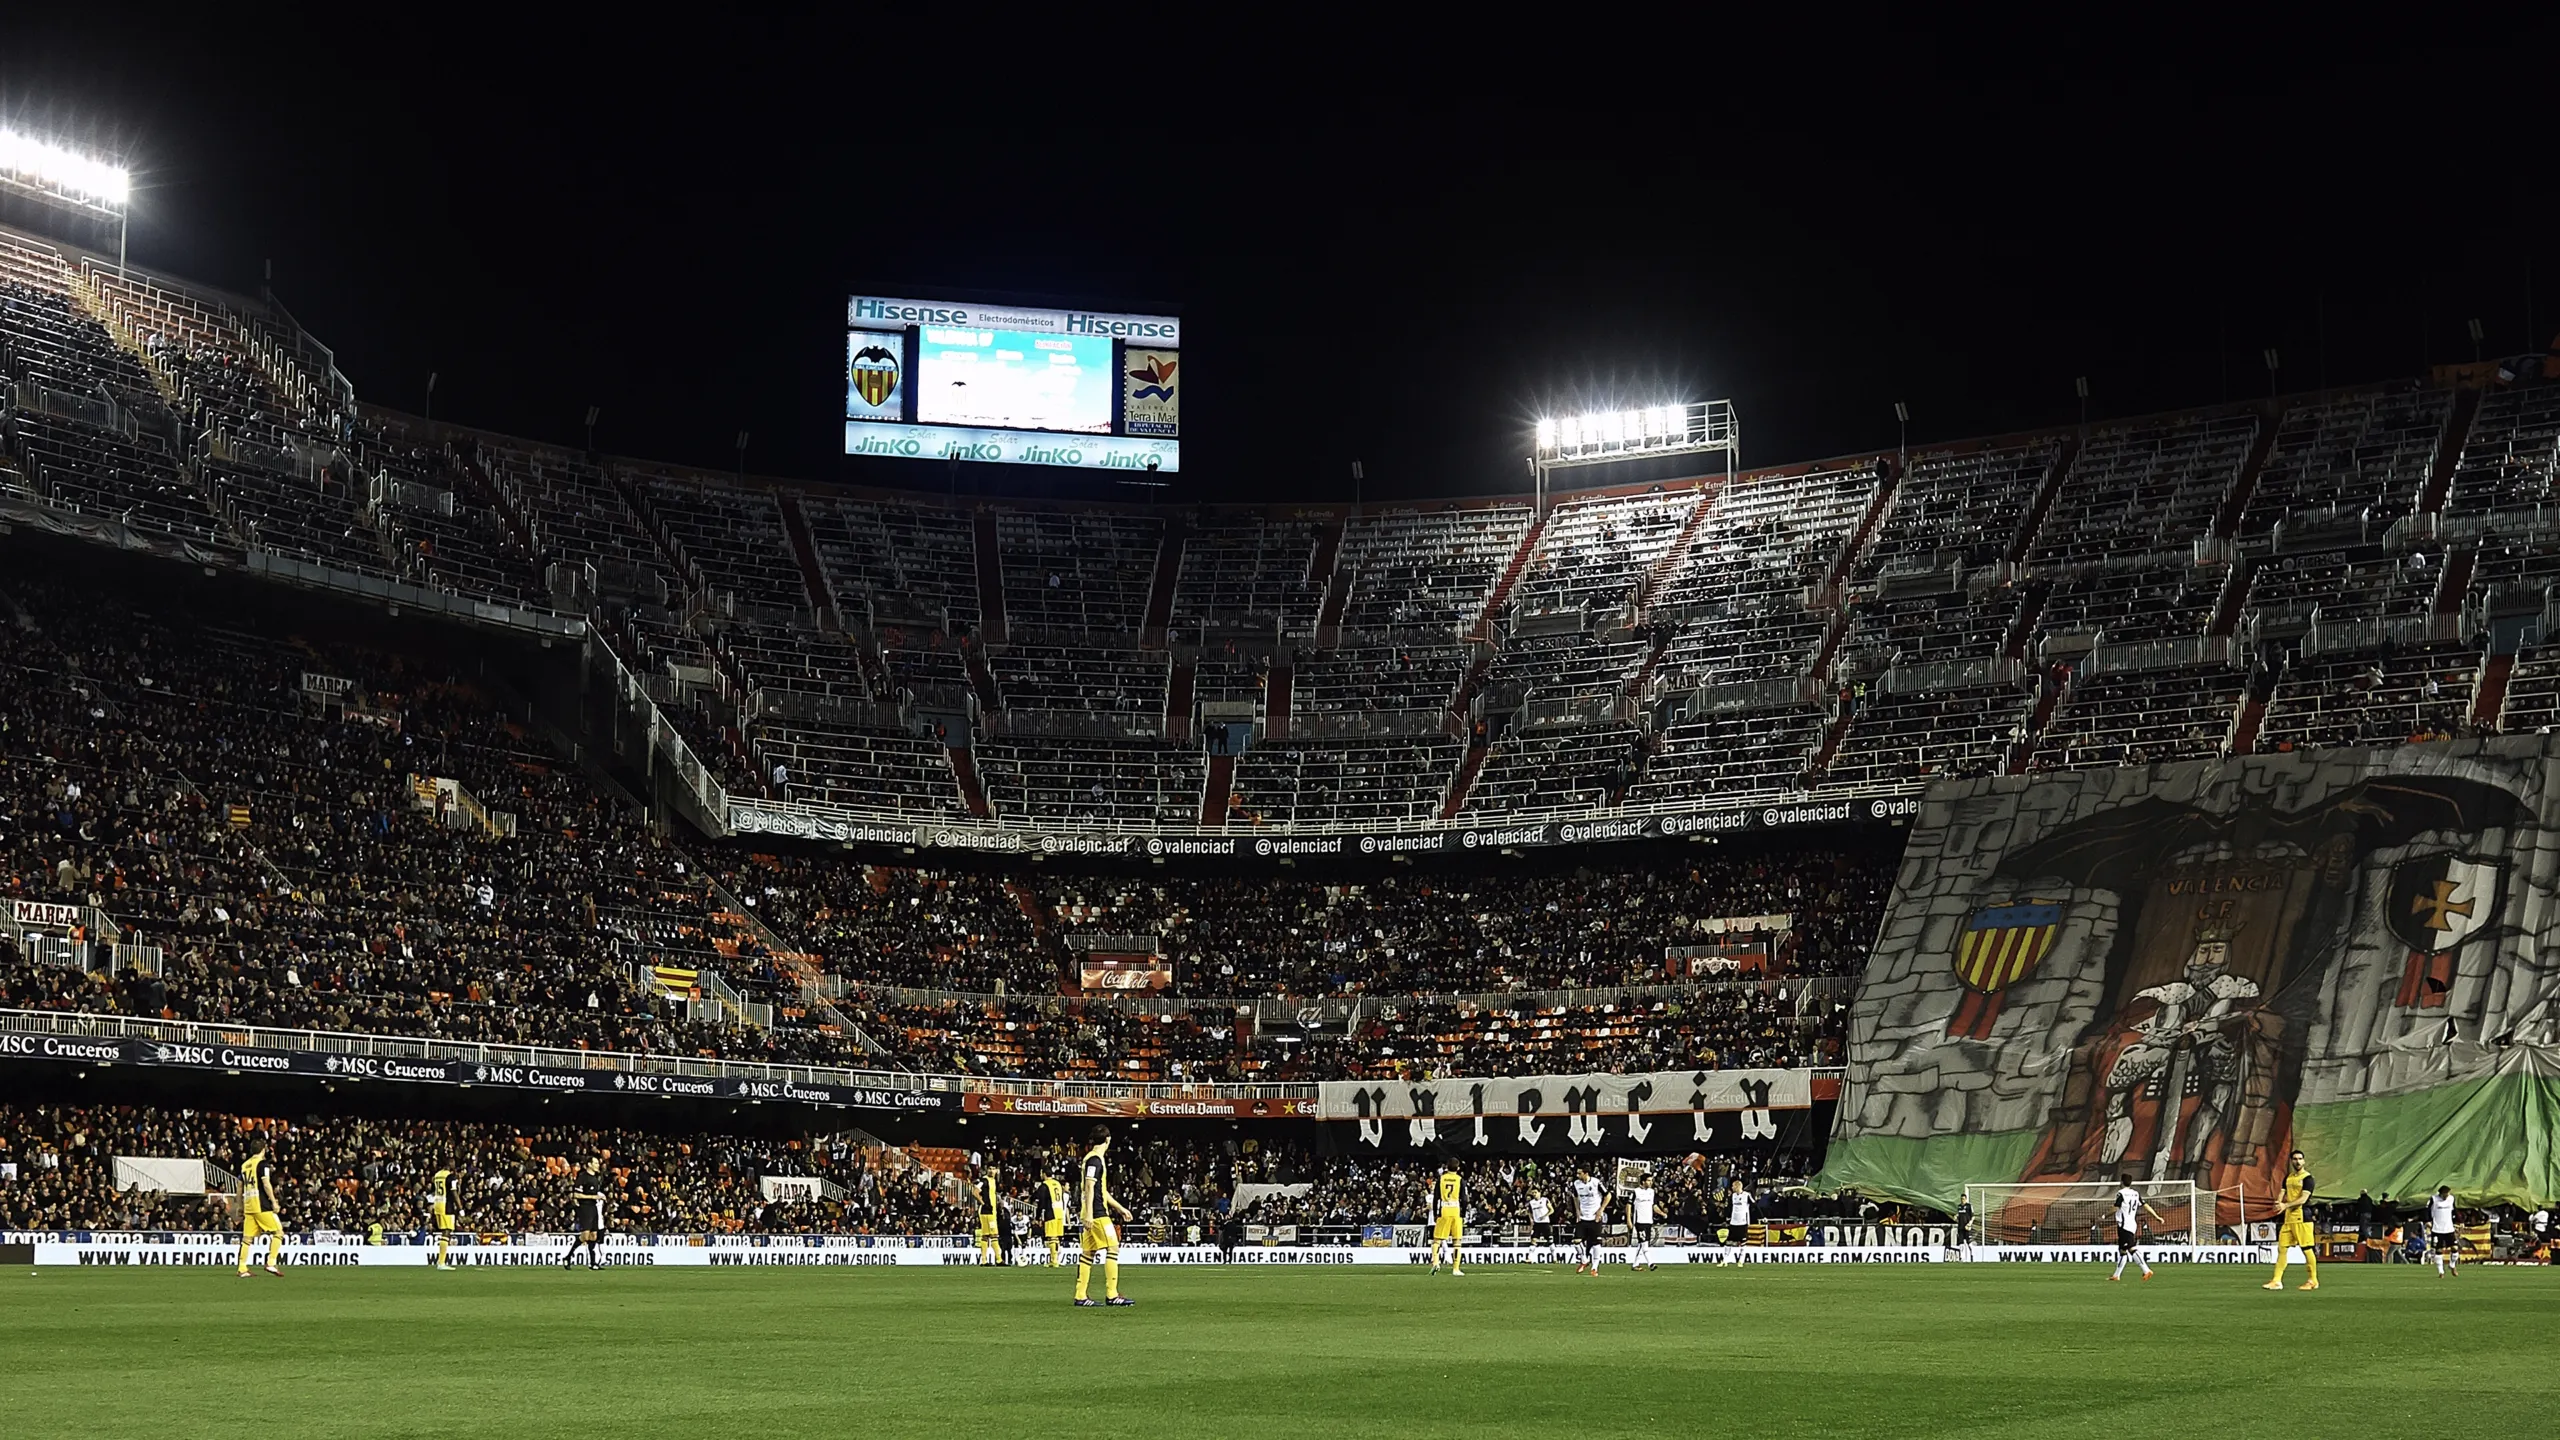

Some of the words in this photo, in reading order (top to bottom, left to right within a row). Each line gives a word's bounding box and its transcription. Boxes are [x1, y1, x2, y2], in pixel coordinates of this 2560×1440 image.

[856, 300, 967, 324] Hisense
[979, 314, 1054, 327] Electrodomésticos
[1066, 314, 1176, 338] Hisense
[1129, 411, 1152, 422] Terra
[1158, 412, 1176, 423] Mar
[907, 428, 936, 440] Solar
[988, 433, 1018, 445] Solar
[1069, 438, 1098, 449] Solar
[306, 674, 348, 692] MARCA
[1763, 803, 1850, 826] @valenciacf
[1871, 799, 1921, 818] @vale
[1560, 820, 1642, 842] @valenciacf
[1661, 811, 1745, 834] @valenciacf
[835, 822, 917, 844] @valenciacf
[935, 830, 1021, 850] @valenciacf
[1463, 827, 1544, 849] @valenciacf
[1041, 836, 1128, 854] @valencacf
[1148, 838, 1235, 855] @valenciacf
[1255, 837, 1342, 855] @valenciacf
[1360, 834, 1444, 853] @valenciacf
[2169, 874, 2283, 896] VALENCIA
[17, 902, 75, 924] MARCA
[0, 1035, 35, 1053] MSC
[44, 1038, 119, 1059] Cruceros
[175, 1047, 214, 1065] MSC
[221, 1049, 290, 1070] Cruceros
[342, 1057, 377, 1075] MSC
[384, 1060, 446, 1079] Cruceros
[490, 1068, 523, 1085] MSC
[528, 1069, 585, 1088] Cruceros
[627, 1075, 657, 1090] MSC
[662, 1076, 714, 1095] Cruceros
[750, 1083, 779, 1098] MSC
[782, 1084, 830, 1102] Cruceros
[864, 1091, 891, 1105] MSC
[895, 1092, 941, 1107] Cruceros
[1014, 1098, 1051, 1112] Estrella
[1052, 1100, 1088, 1113] Damm
[1150, 1101, 1197, 1115] Estrella
[1198, 1102, 1234, 1115] Damm
[1446, 1184, 1454, 1198] 7
[709, 1253, 897, 1265] WWW.VALENCIACF.COM/SOCIOS
